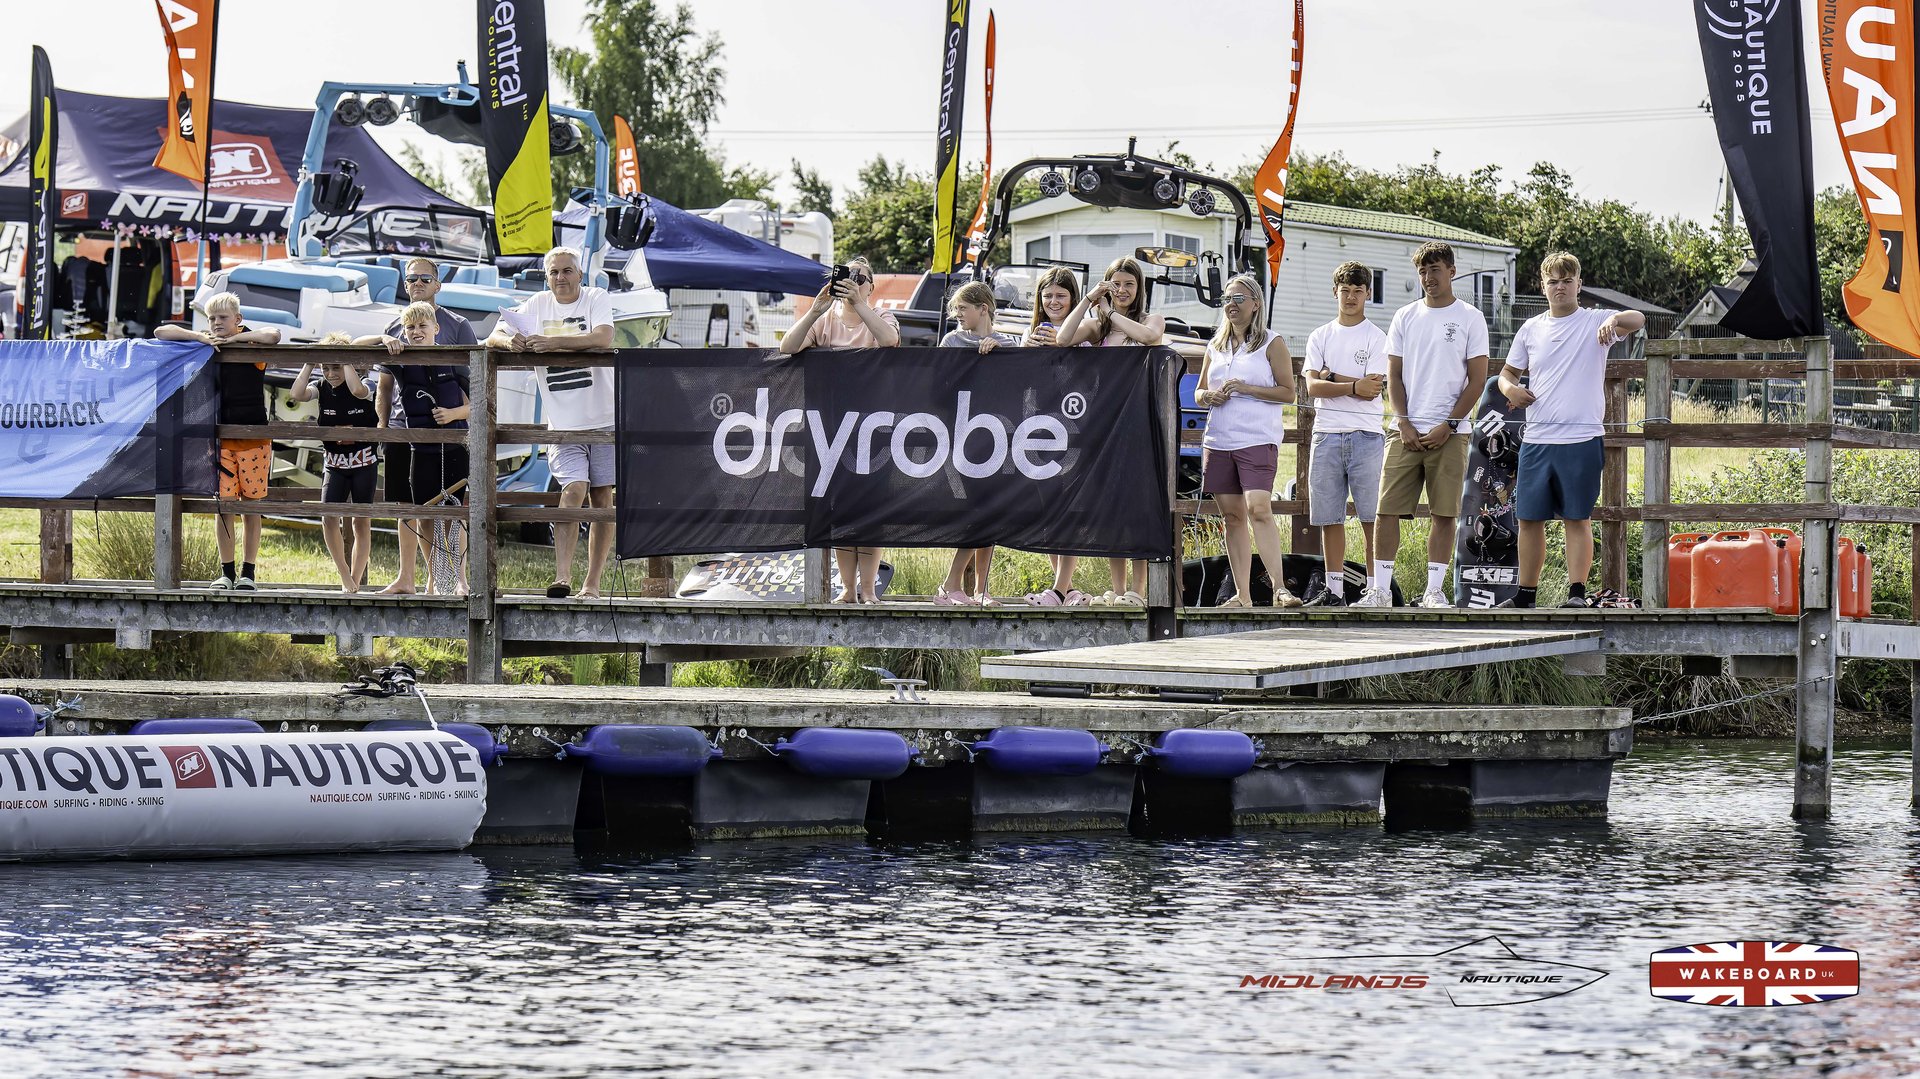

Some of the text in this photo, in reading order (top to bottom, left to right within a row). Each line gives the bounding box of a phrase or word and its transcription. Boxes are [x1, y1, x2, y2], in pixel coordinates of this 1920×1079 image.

[493, 0, 528, 107] entral
[1732, 50, 1745, 102] 2025
[939, 27, 961, 140] central
[0, 400, 104, 429] OURBACK
[0, 745, 163, 794] TIQUE
[207, 741, 477, 788] NAUTIQUE
[54, 798, 89, 808] SURFING
[99, 797, 128, 807] RIDING
[138, 796, 164, 806] SKIING
[310, 789, 479, 803] NAUTIQUE.COM SURFING RIDING SKIING
